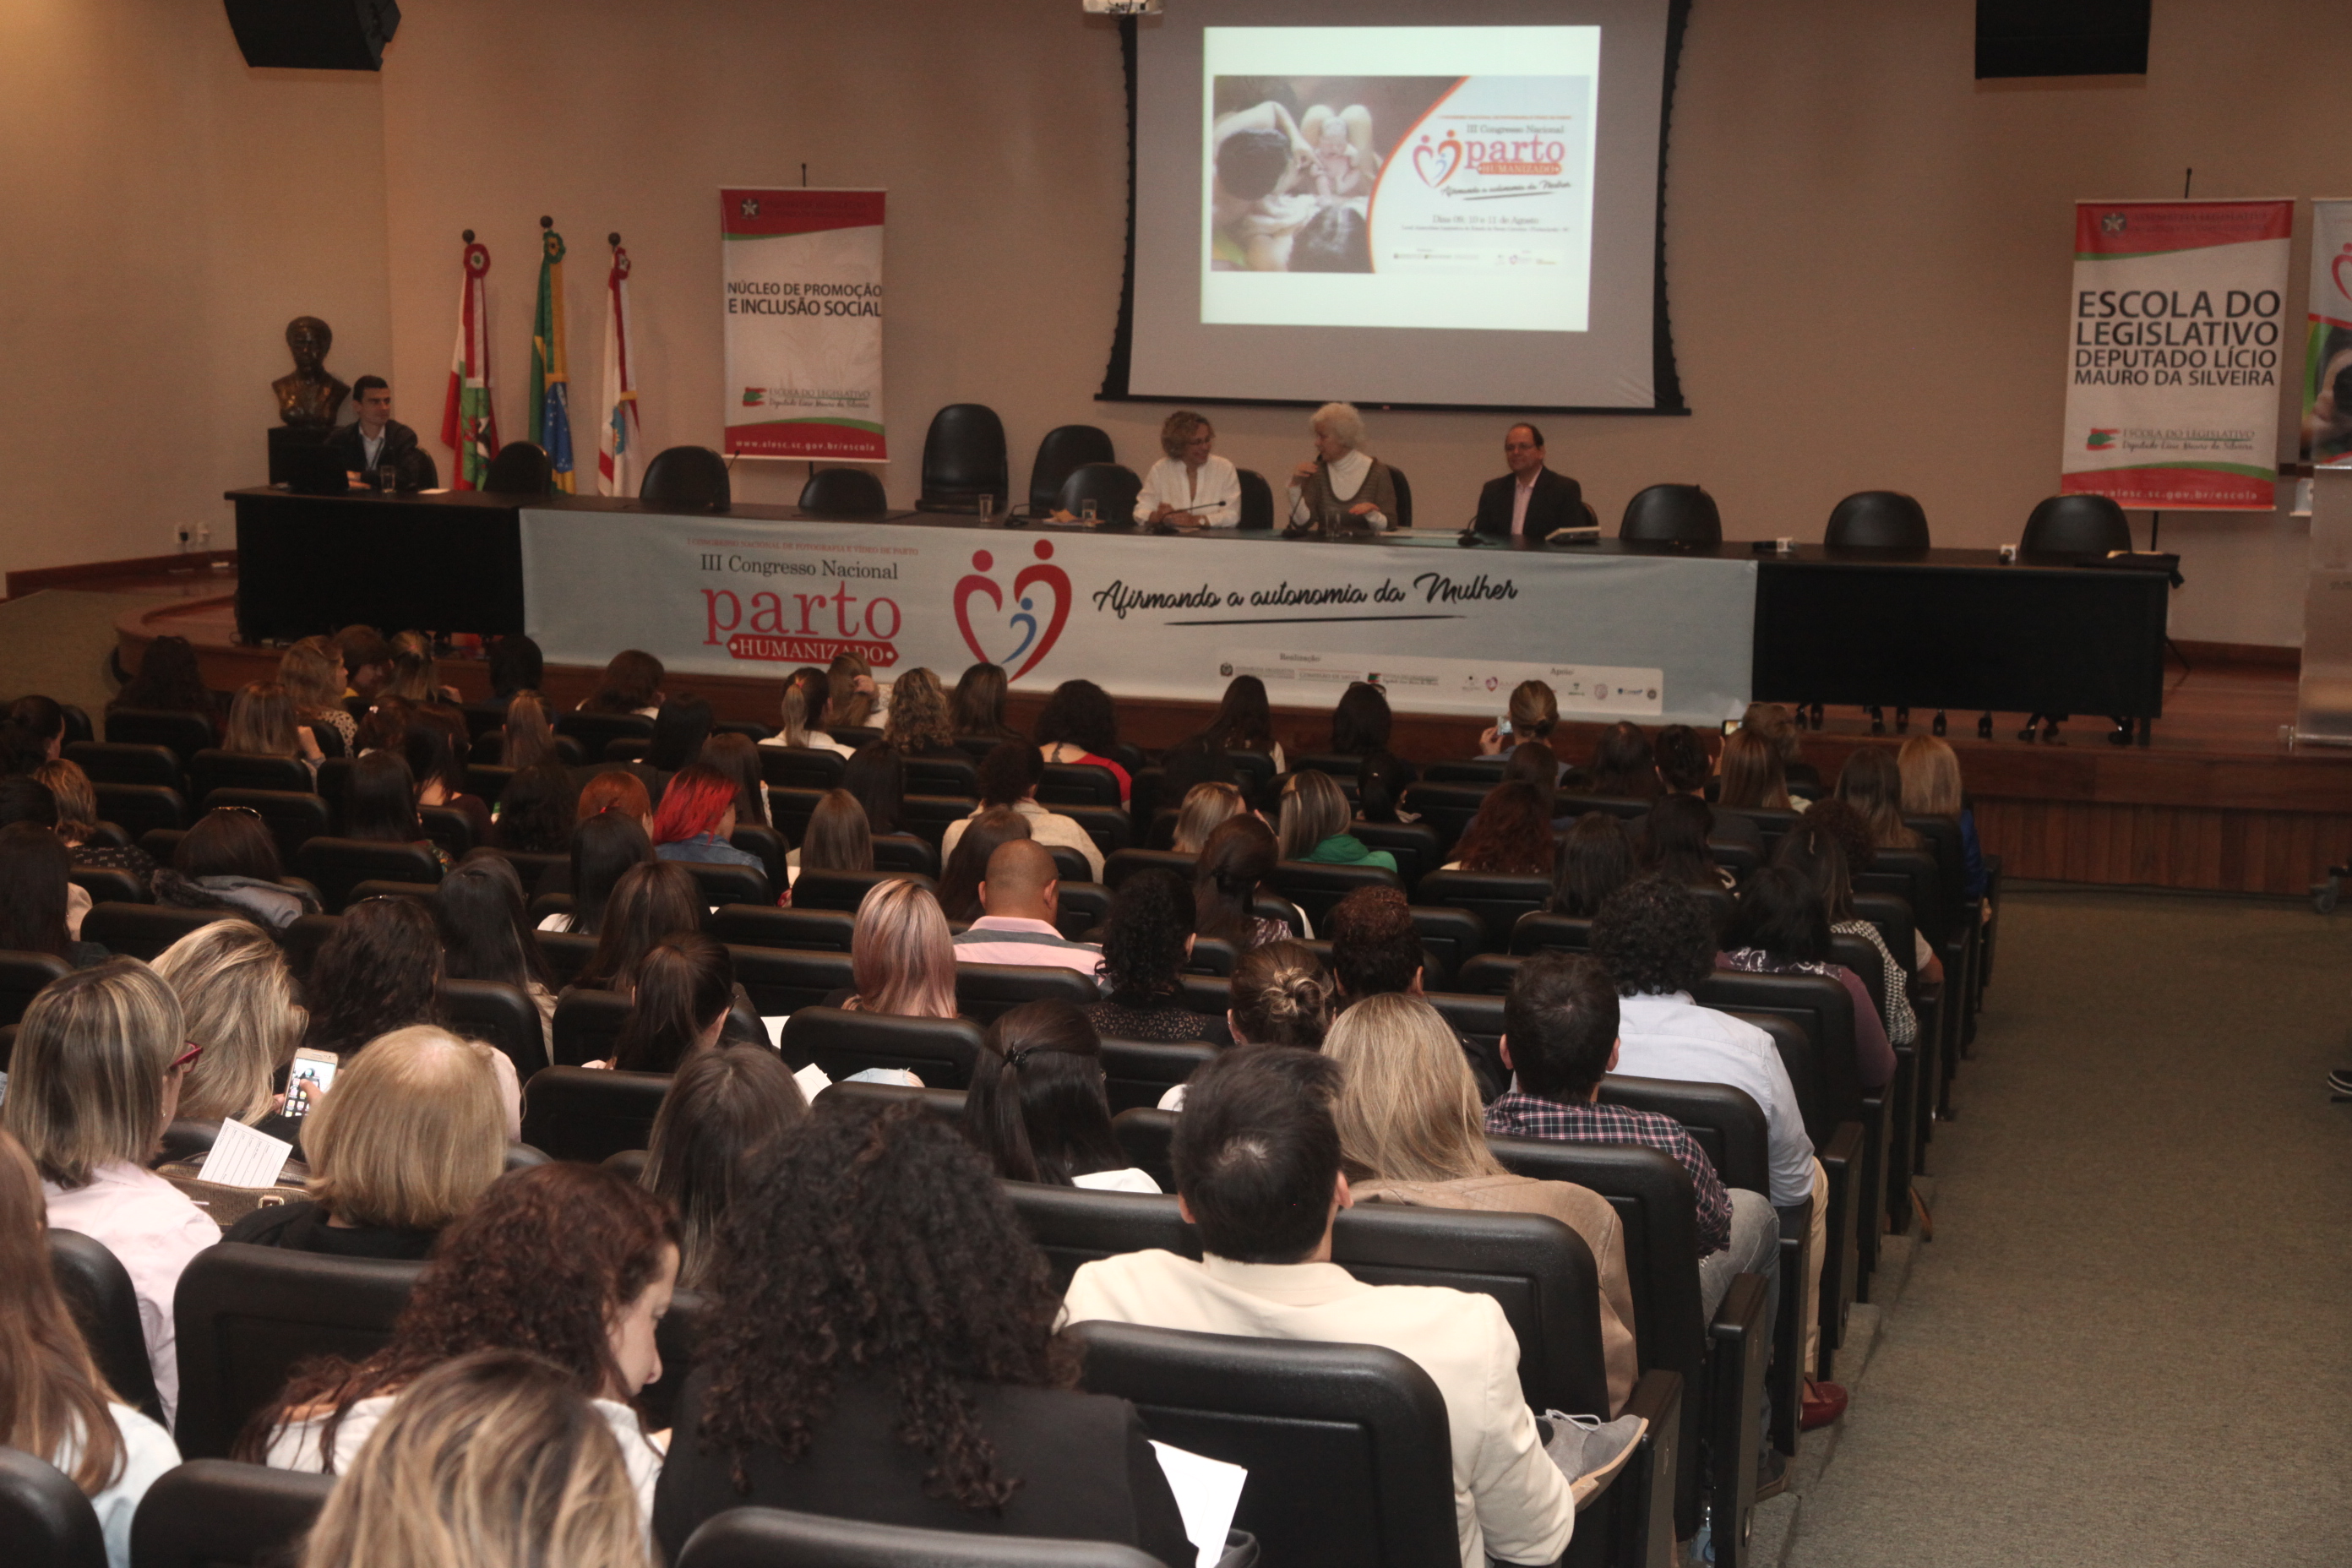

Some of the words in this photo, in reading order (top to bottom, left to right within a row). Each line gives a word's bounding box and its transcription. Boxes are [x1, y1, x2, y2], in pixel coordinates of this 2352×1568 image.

[1526, 124, 1565, 133] Nacional
[1464, 134, 1565, 169] parto
[1481, 163, 1555, 174] HUMANIZADO
[727, 280, 781, 296] NÚCLEO
[783, 283, 801, 297] DE
[803, 280, 883, 300] PROMOÇÃO
[728, 299, 738, 314] E
[740, 298, 819, 317] INCLUSÃO
[824, 300, 882, 318] SOCIAL
[2077, 291, 2213, 318] ESCOLA
[2225, 290, 2281, 318] DO
[2077, 321, 2278, 346] LEGISLATIVO
[2075, 349, 2207, 368] DEPUTADO
[2213, 345, 2277, 368] LÍCIO
[2074, 370, 2149, 385] MAURO
[2154, 370, 2182, 385] DA
[2188, 370, 2275, 386] SILVEIRA
[801, 389, 814, 398] DO
[817, 389, 871, 400] LEGISLATIVO
[2122, 429, 2163, 438] ESCOLA
[2165, 429, 2184, 438] DO
[2186, 429, 2256, 439] LEGISLATIVO
[741, 541, 780, 550] NACIONAL
[795, 542, 846, 553] FOTOGRAFIA
[880, 547, 891, 555] DE
[893, 547, 919, 556] PARTO
[700, 553, 722, 572] III
[728, 555, 817, 577] Congresso
[822, 559, 898, 580] Nacional
[1092, 580, 1221, 619] Afirmando
[1227, 590, 1245, 607] a
[1250, 580, 1368, 607] autonomia
[1373, 579, 1407, 604] da
[1413, 571, 1519, 604] Mulher
[701, 580, 901, 645] parto
